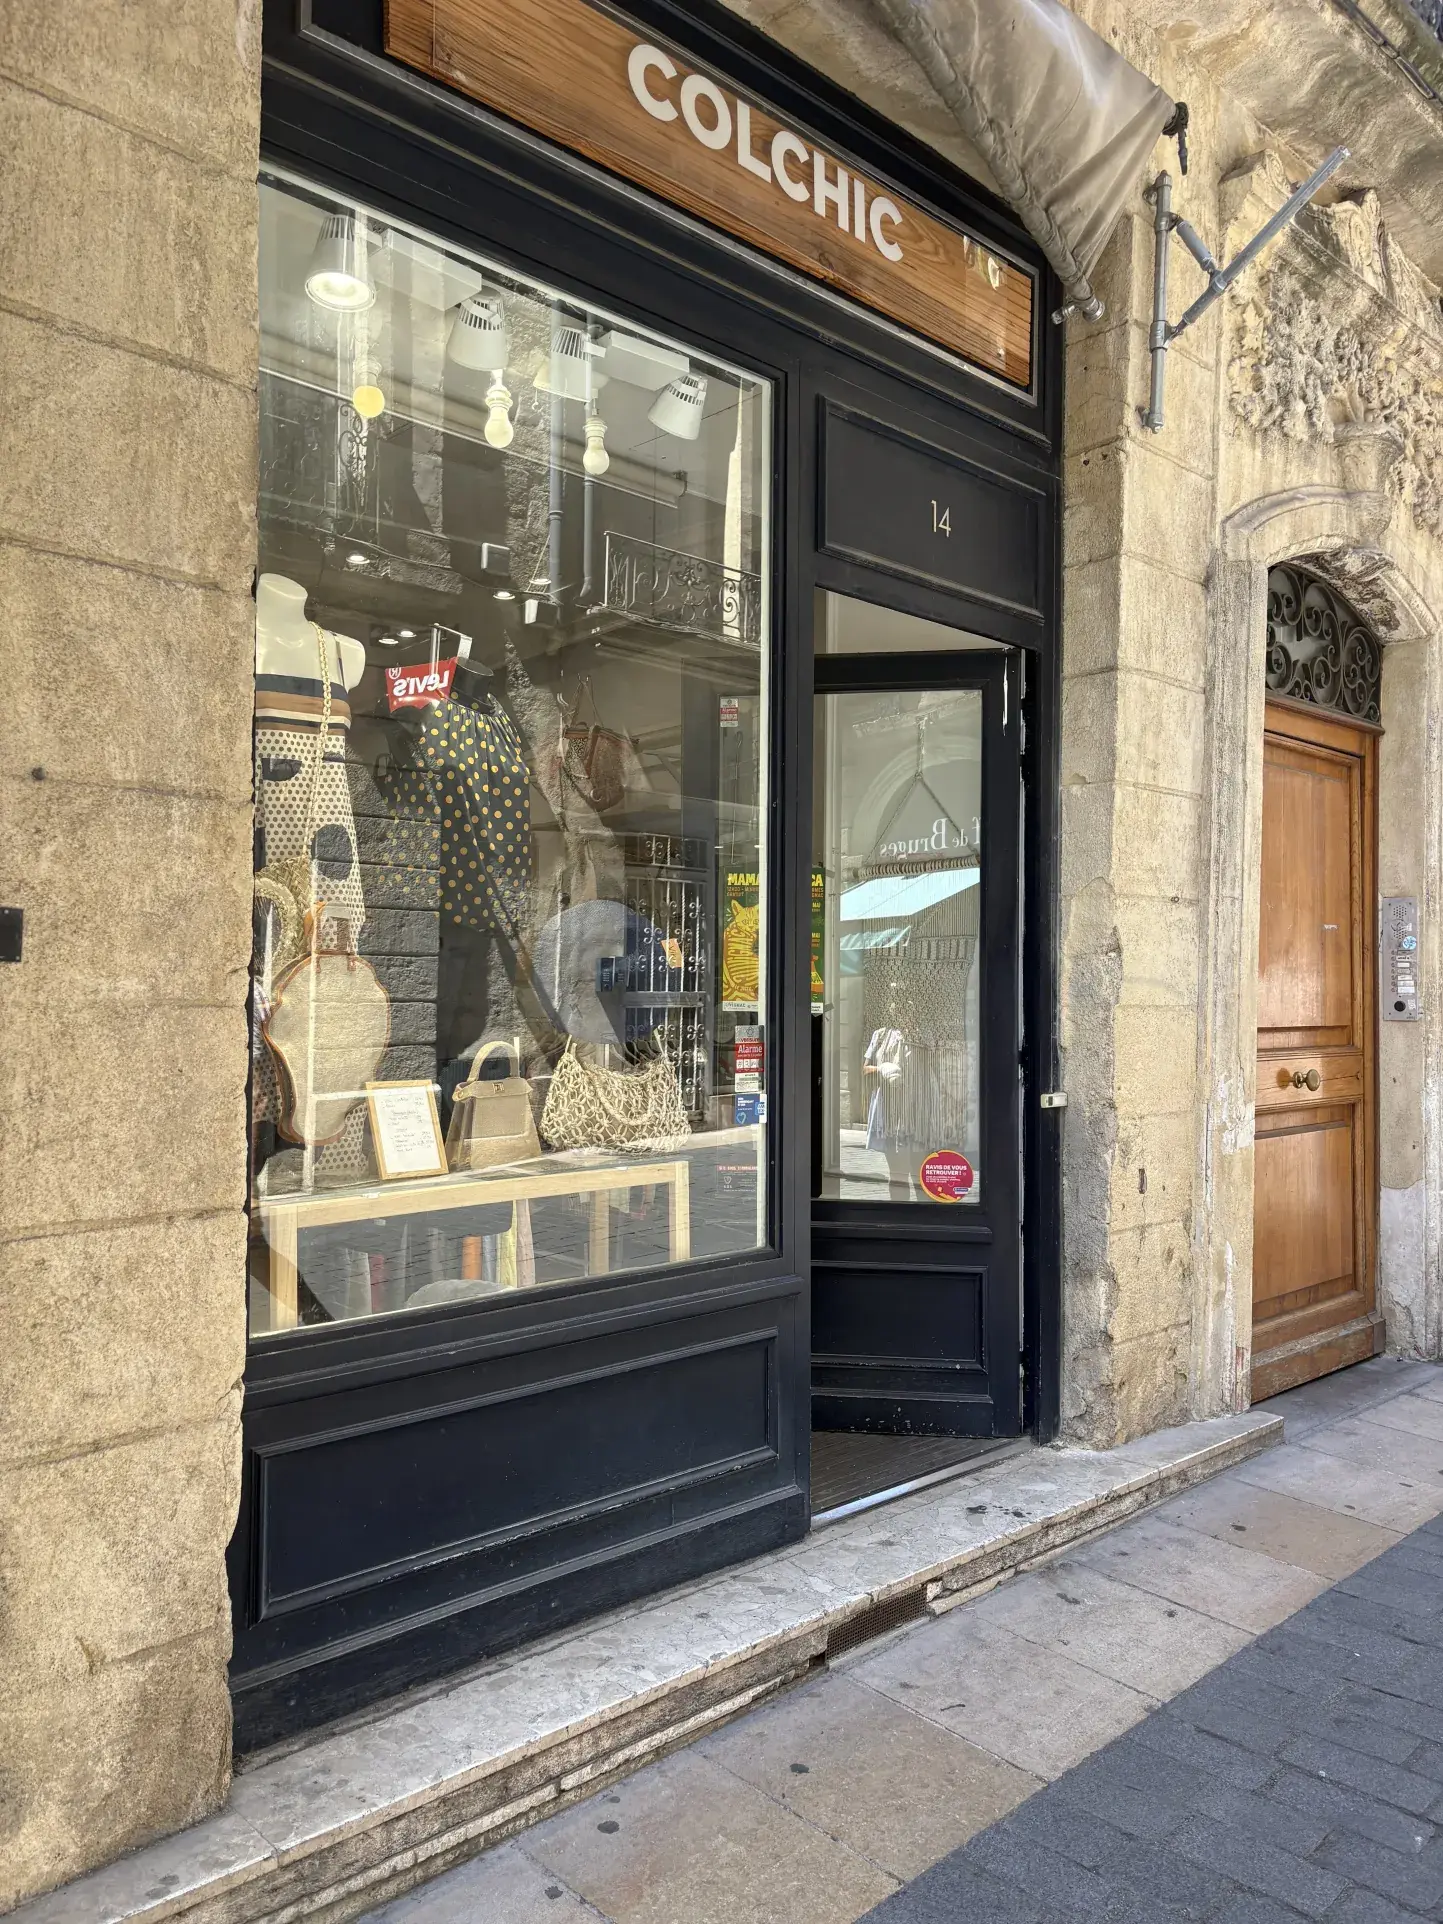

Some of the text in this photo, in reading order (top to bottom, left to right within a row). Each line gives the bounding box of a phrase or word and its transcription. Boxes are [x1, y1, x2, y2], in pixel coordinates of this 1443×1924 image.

[627, 44, 904, 262] COLCHIC
[931, 499, 951, 538] 14
[738, 1044, 763, 1054] Alarme
